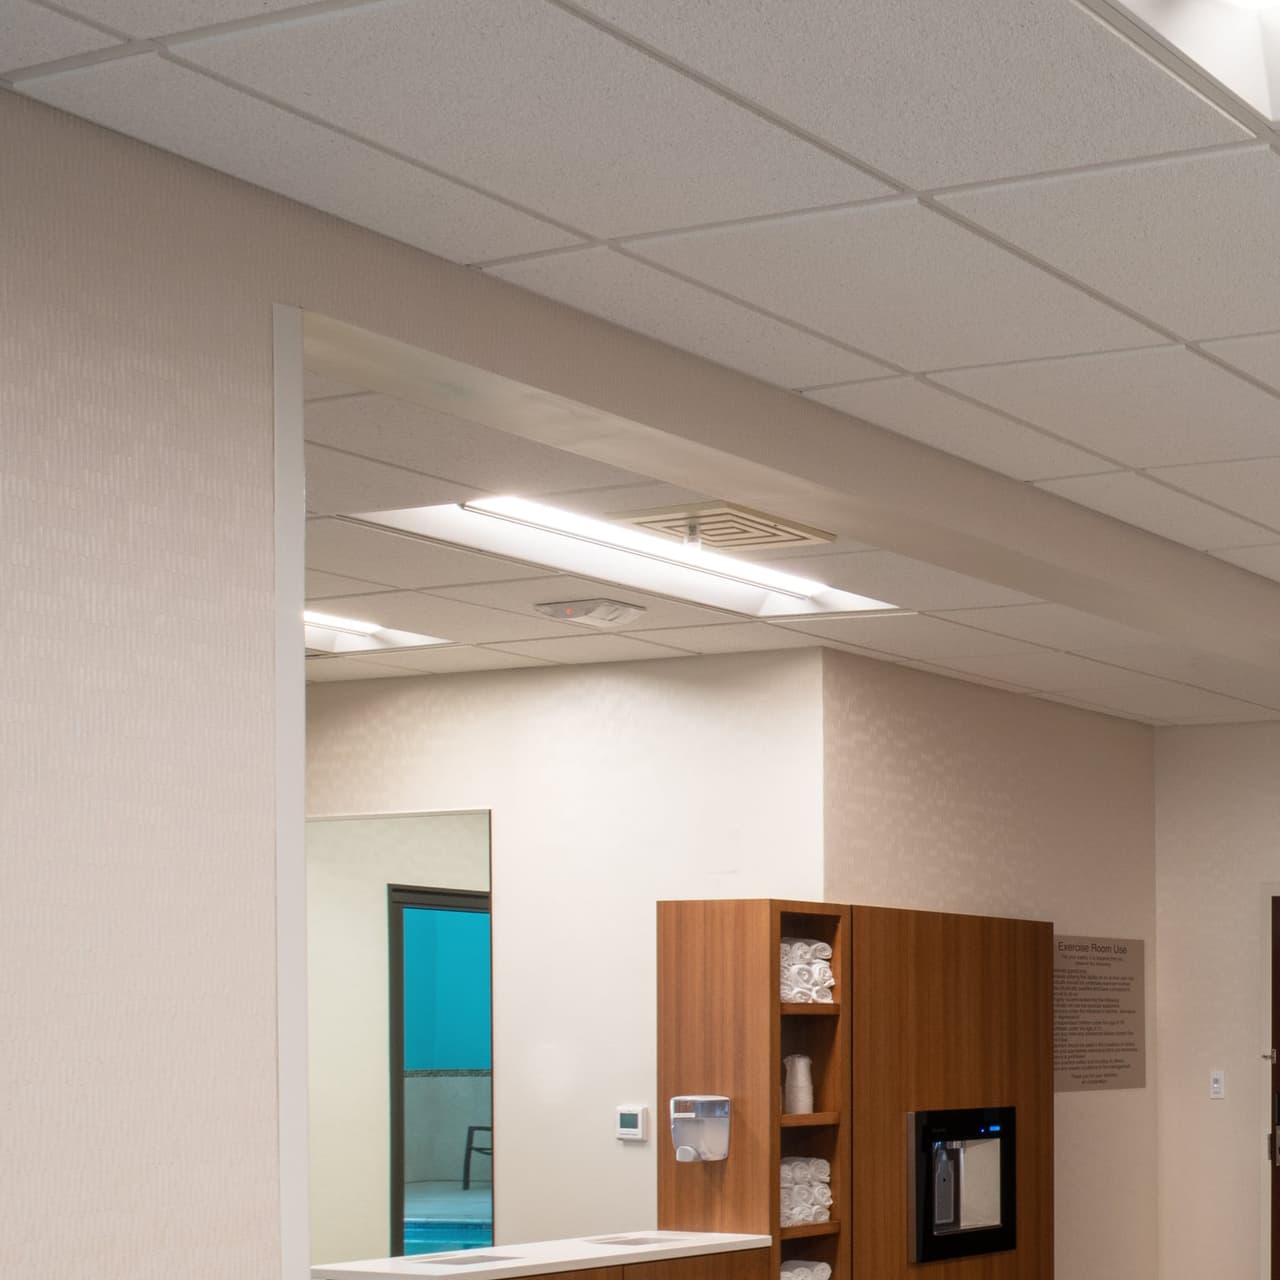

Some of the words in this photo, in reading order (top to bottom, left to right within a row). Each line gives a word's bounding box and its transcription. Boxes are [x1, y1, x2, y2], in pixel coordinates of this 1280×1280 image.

[1057, 942, 1089, 953] Exercise
[1091, 943, 1112, 953] Room
[1113, 945, 1128, 954] Use
